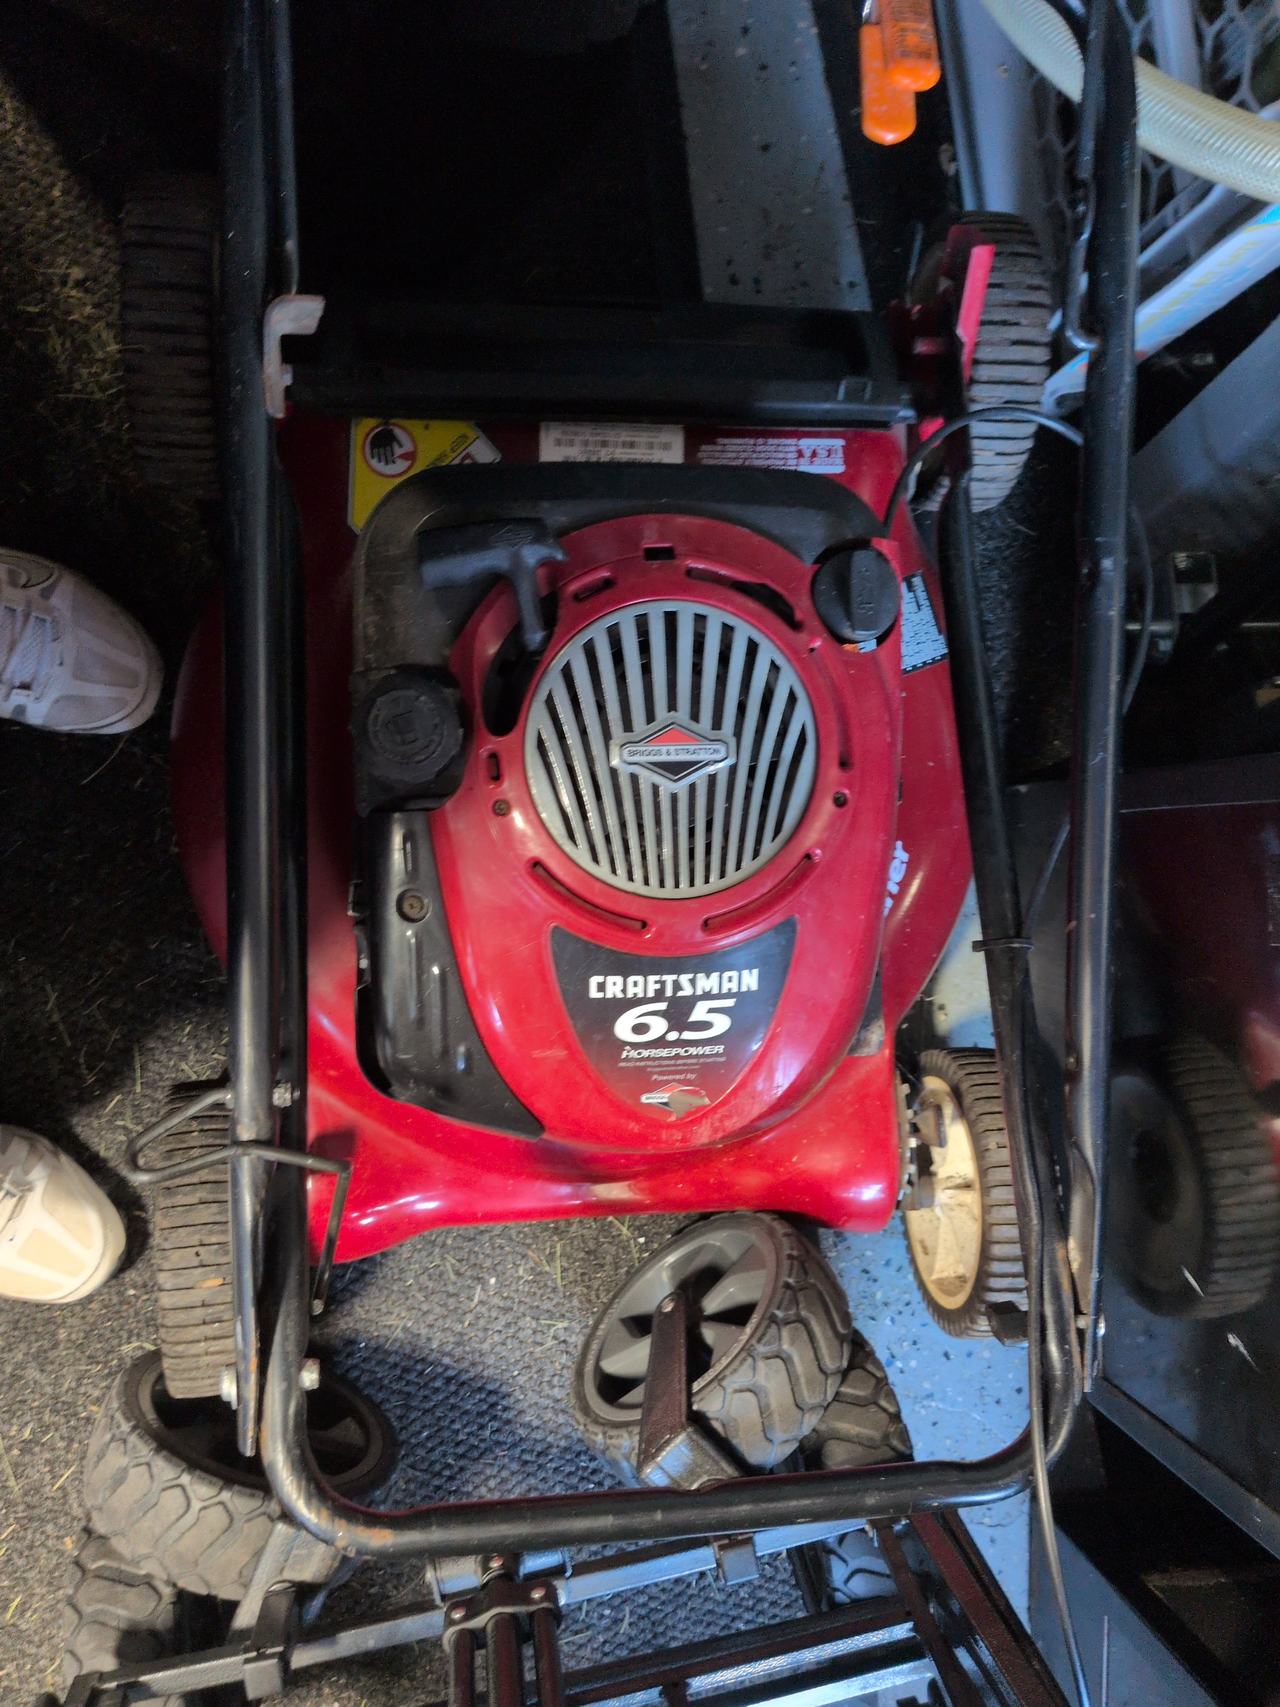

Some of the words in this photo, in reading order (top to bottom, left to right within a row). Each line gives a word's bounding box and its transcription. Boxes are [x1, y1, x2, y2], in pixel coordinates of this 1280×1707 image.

[628, 748, 662, 757] BRIGGS
[666, 749, 671, 757] &
[674, 747, 720, 756] STRATTON
[588, 968, 759, 998] CRAFTSMAN
[613, 999, 737, 1043] 6.5
[621, 1045, 725, 1059] HORSEPOWER
[652, 1073, 685, 1081] Powered
